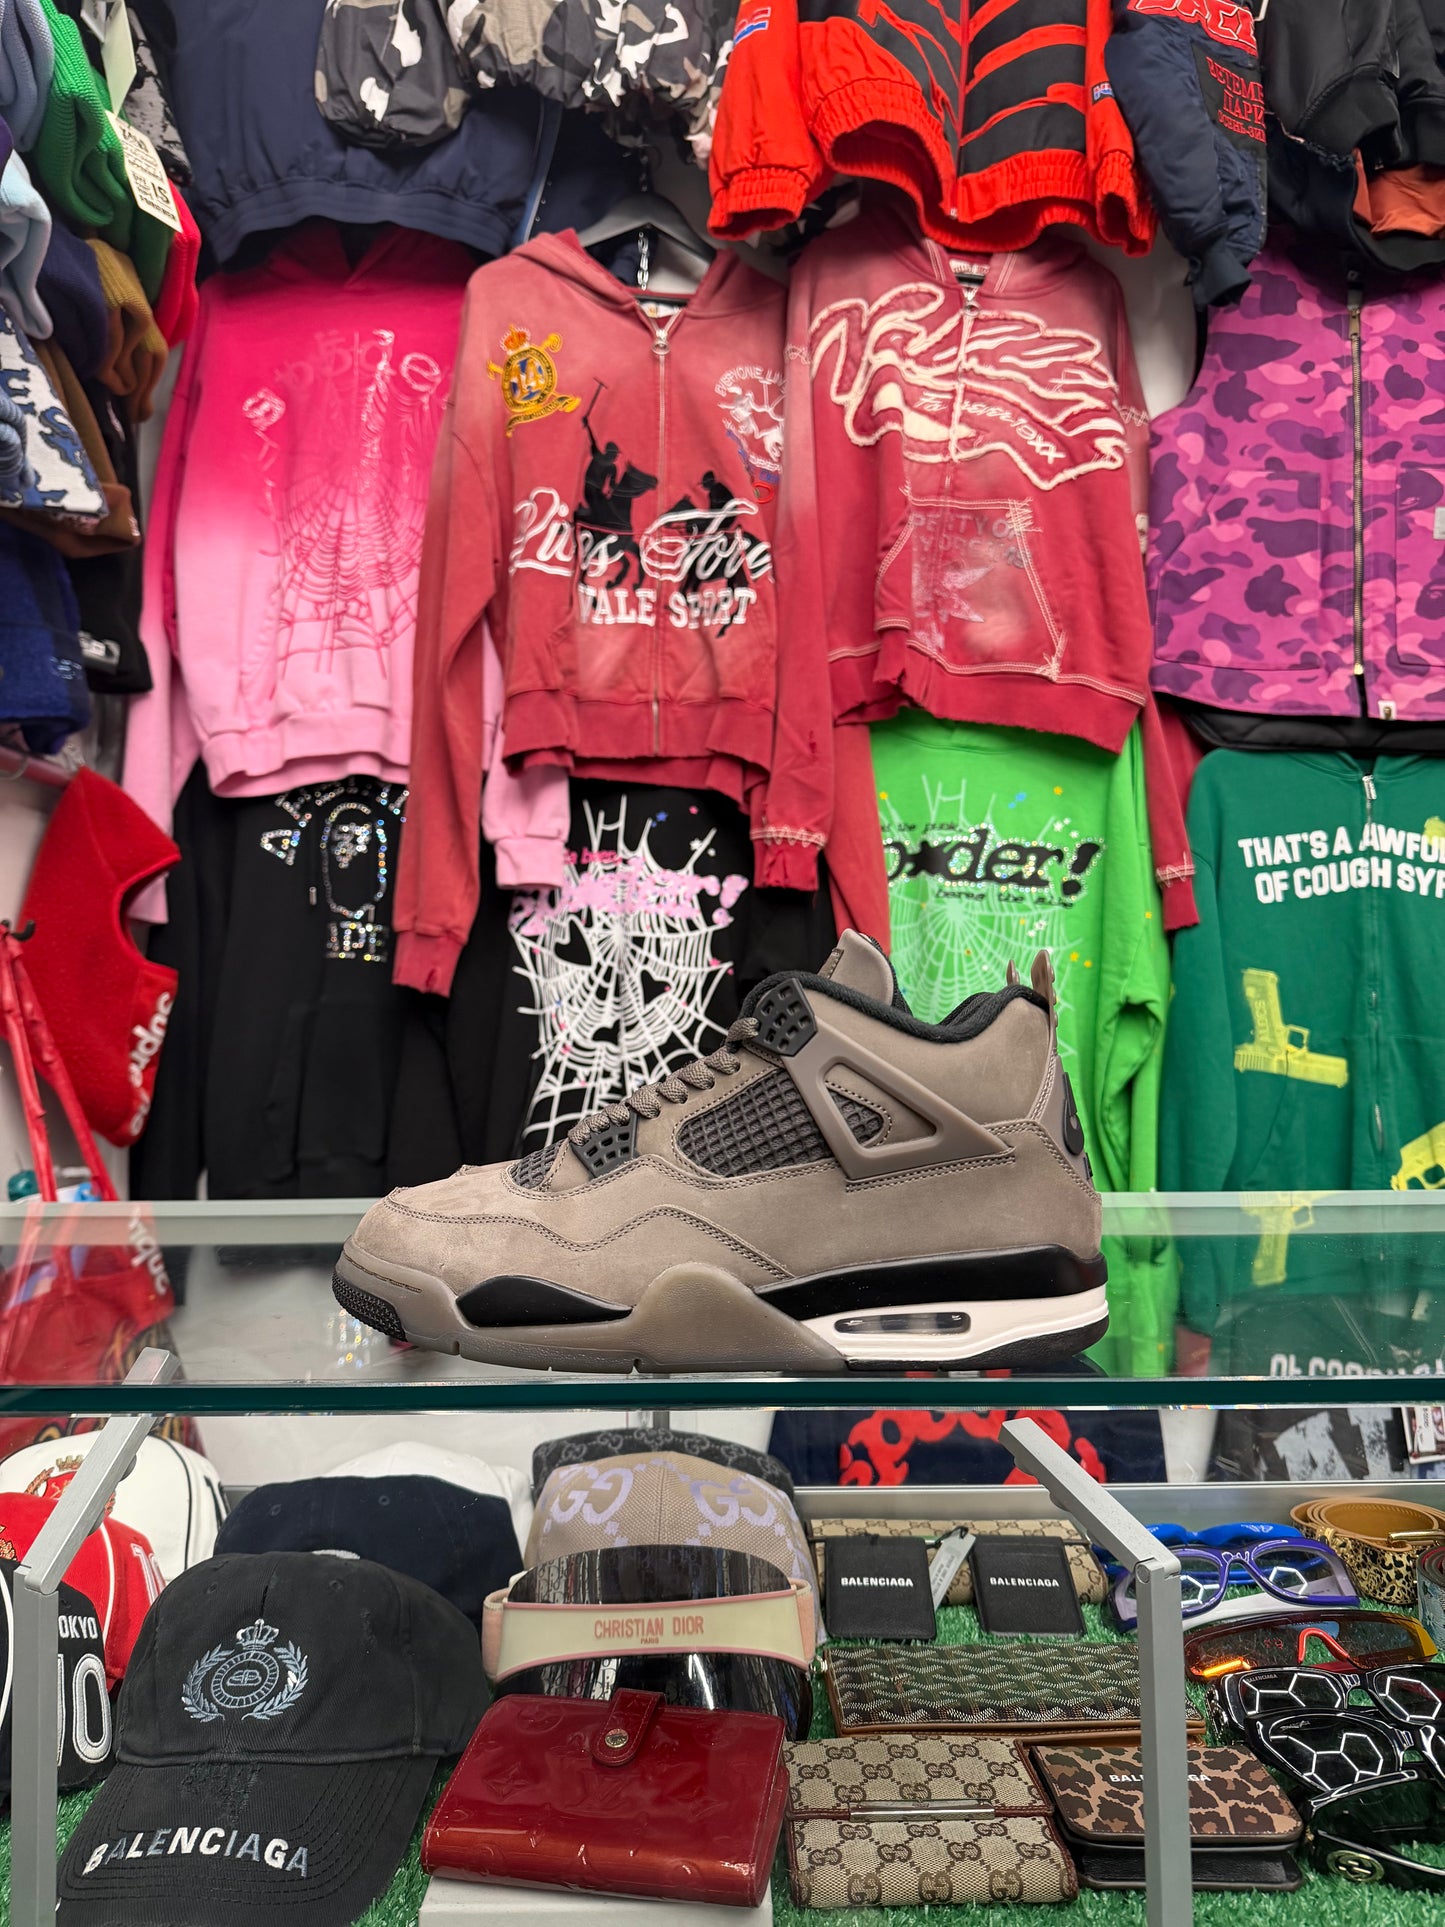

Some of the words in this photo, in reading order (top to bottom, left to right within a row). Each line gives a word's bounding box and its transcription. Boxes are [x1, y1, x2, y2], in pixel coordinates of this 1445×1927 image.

[577, 585, 657, 627] VALE
[668, 588, 757, 629] SPORT
[1237, 829, 1328, 868] THAT'S
[1332, 826, 1353, 856] A
[1358, 822, 1445, 866] AWFU
[1255, 870, 1290, 904] OF
[1292, 856, 1392, 899] COUGH
[840, 1577, 914, 1588] BALENCIAGA
[989, 1576, 1060, 1588] BALENCIAGA
[58, 1615, 98, 1639] OKYO
[594, 1617, 664, 1639] CHRISTIAN
[672, 1615, 704, 1636] DIOR
[640, 1637, 659, 1645] PARIS
[82, 1826, 309, 1878] BALENCIAGA
